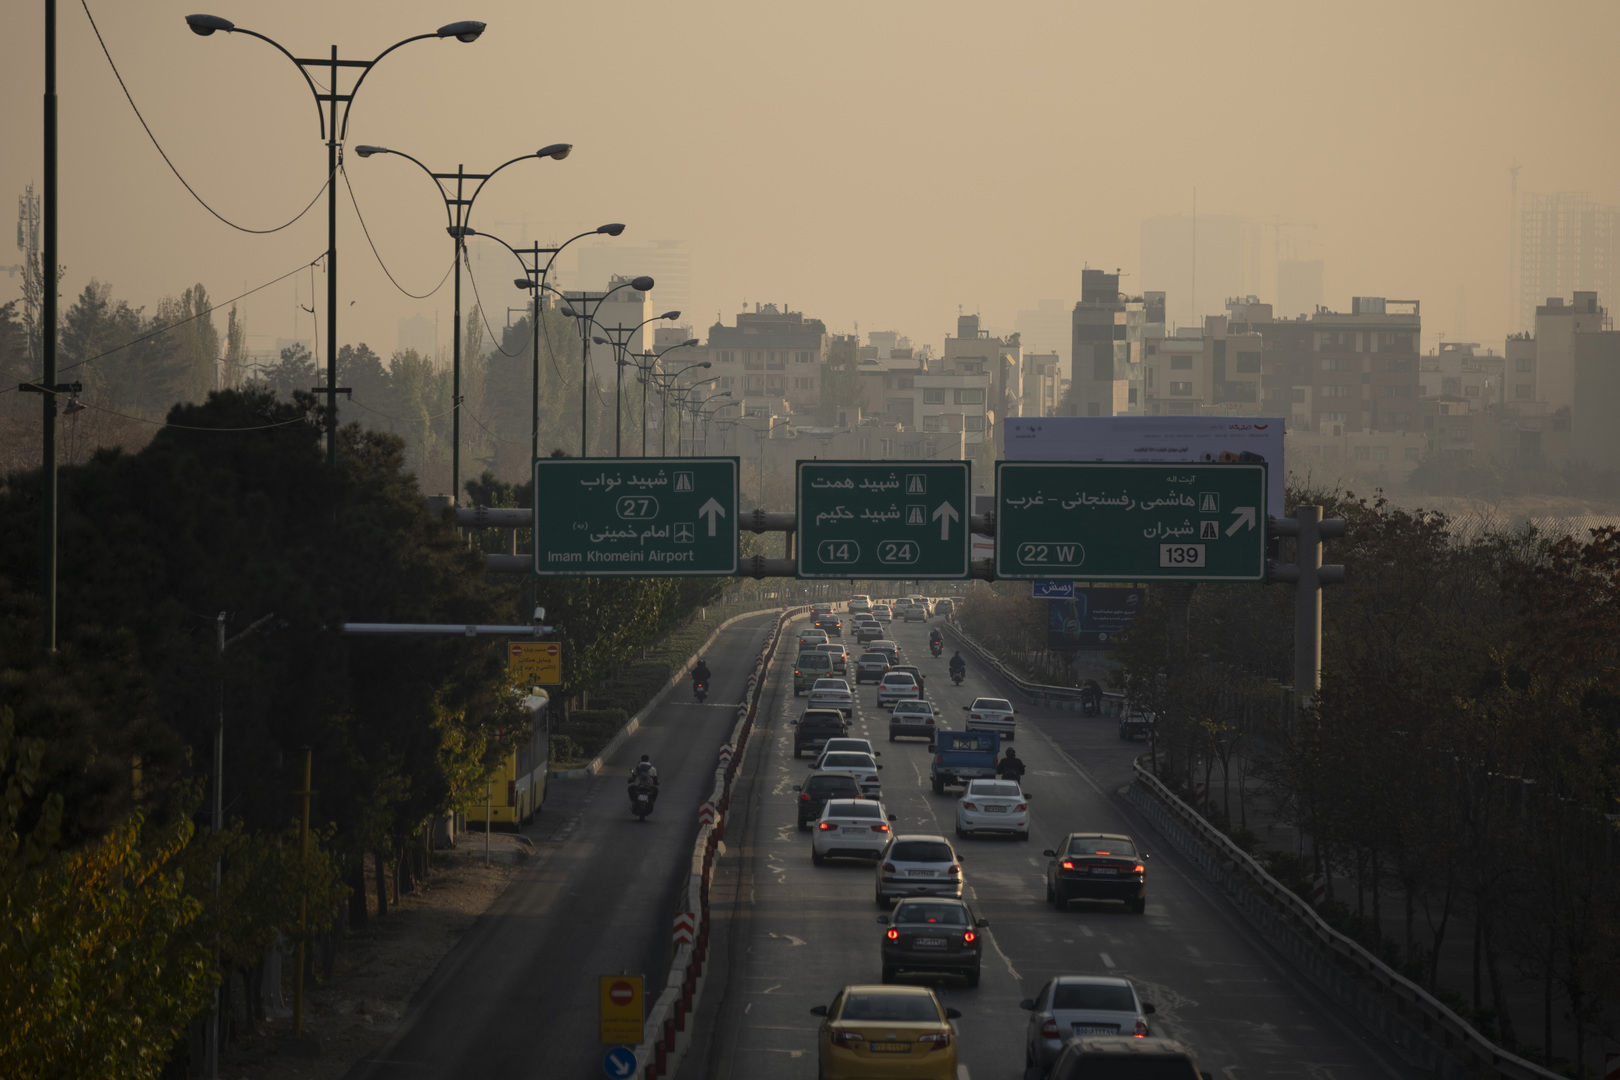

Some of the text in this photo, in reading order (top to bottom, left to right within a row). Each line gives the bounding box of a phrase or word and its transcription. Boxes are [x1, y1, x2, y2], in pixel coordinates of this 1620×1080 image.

[580, 469, 668, 492] شهید نواب
[810, 472, 900, 493] شهید همت
[1178, 474, 1197, 484] آیت
[623, 499, 650, 517] 27
[1006, 490, 1045, 510] غرب
[1061, 489, 1137, 511] رفسنجانی
[1140, 490, 1196, 511] هاشمی
[815, 503, 902, 526] شهید حکیم
[589, 524, 638, 543] خمینی
[640, 524, 670, 546] امام
[1143, 519, 1195, 540] شهران
[547, 550, 695, 564] Imam Khomeini Airport
[826, 543, 850, 561] 14
[884, 543, 912, 561] 24
[1024, 545, 1076, 562] 22 W
[1165, 546, 1199, 564] 139
